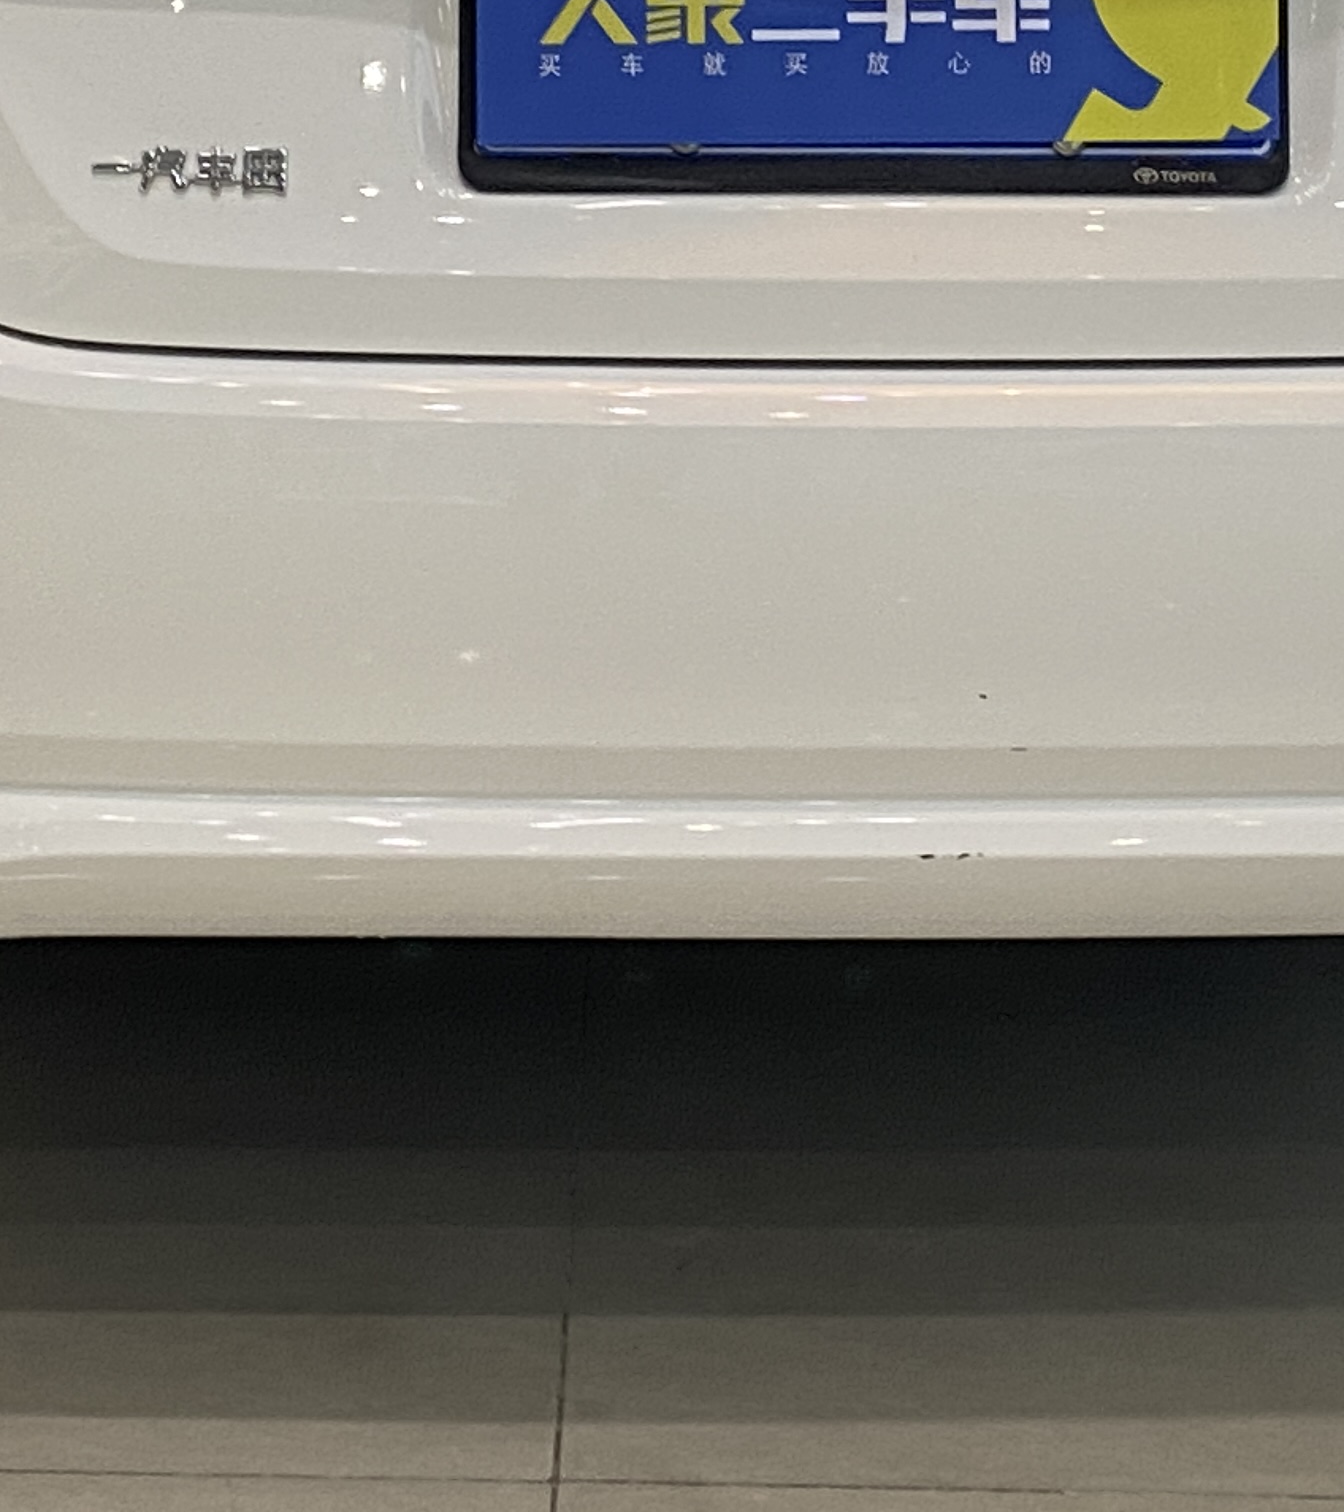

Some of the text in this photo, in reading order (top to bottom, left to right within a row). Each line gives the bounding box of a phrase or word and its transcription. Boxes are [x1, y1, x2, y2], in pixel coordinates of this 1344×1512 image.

[537, 51, 1053, 78] 买车就买放心的
[1161, 170, 1217, 185] TOYOTA
